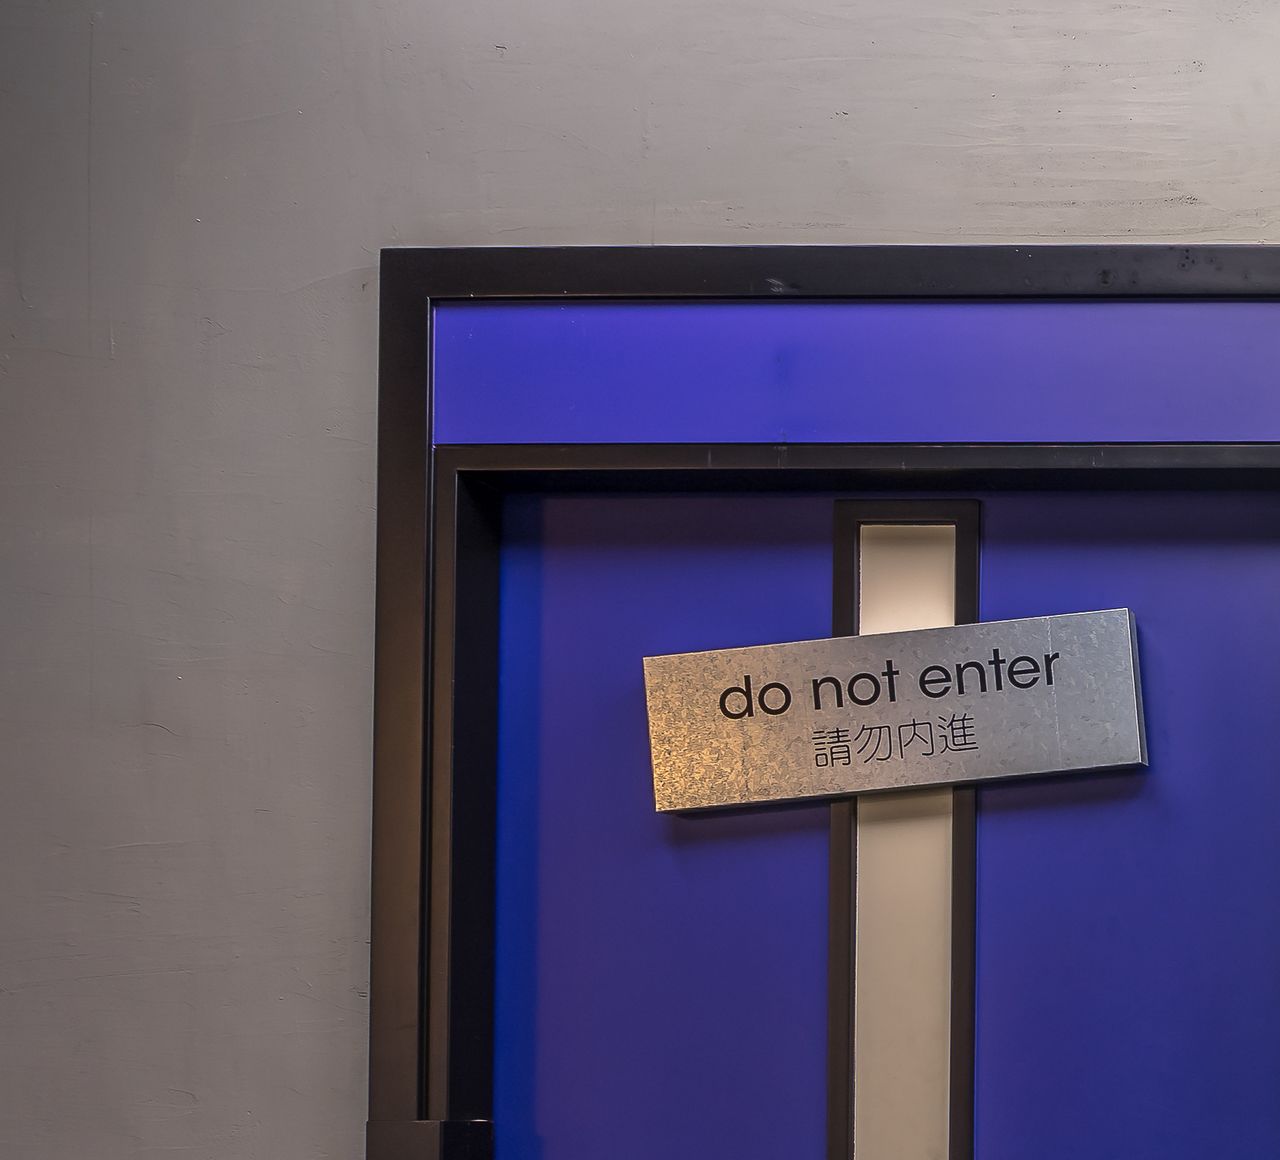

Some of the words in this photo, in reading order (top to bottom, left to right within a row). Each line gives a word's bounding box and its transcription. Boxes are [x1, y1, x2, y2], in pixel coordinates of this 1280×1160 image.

[719, 675, 791, 720] do
[812, 659, 899, 710] not
[918, 648, 1060, 699] enter
